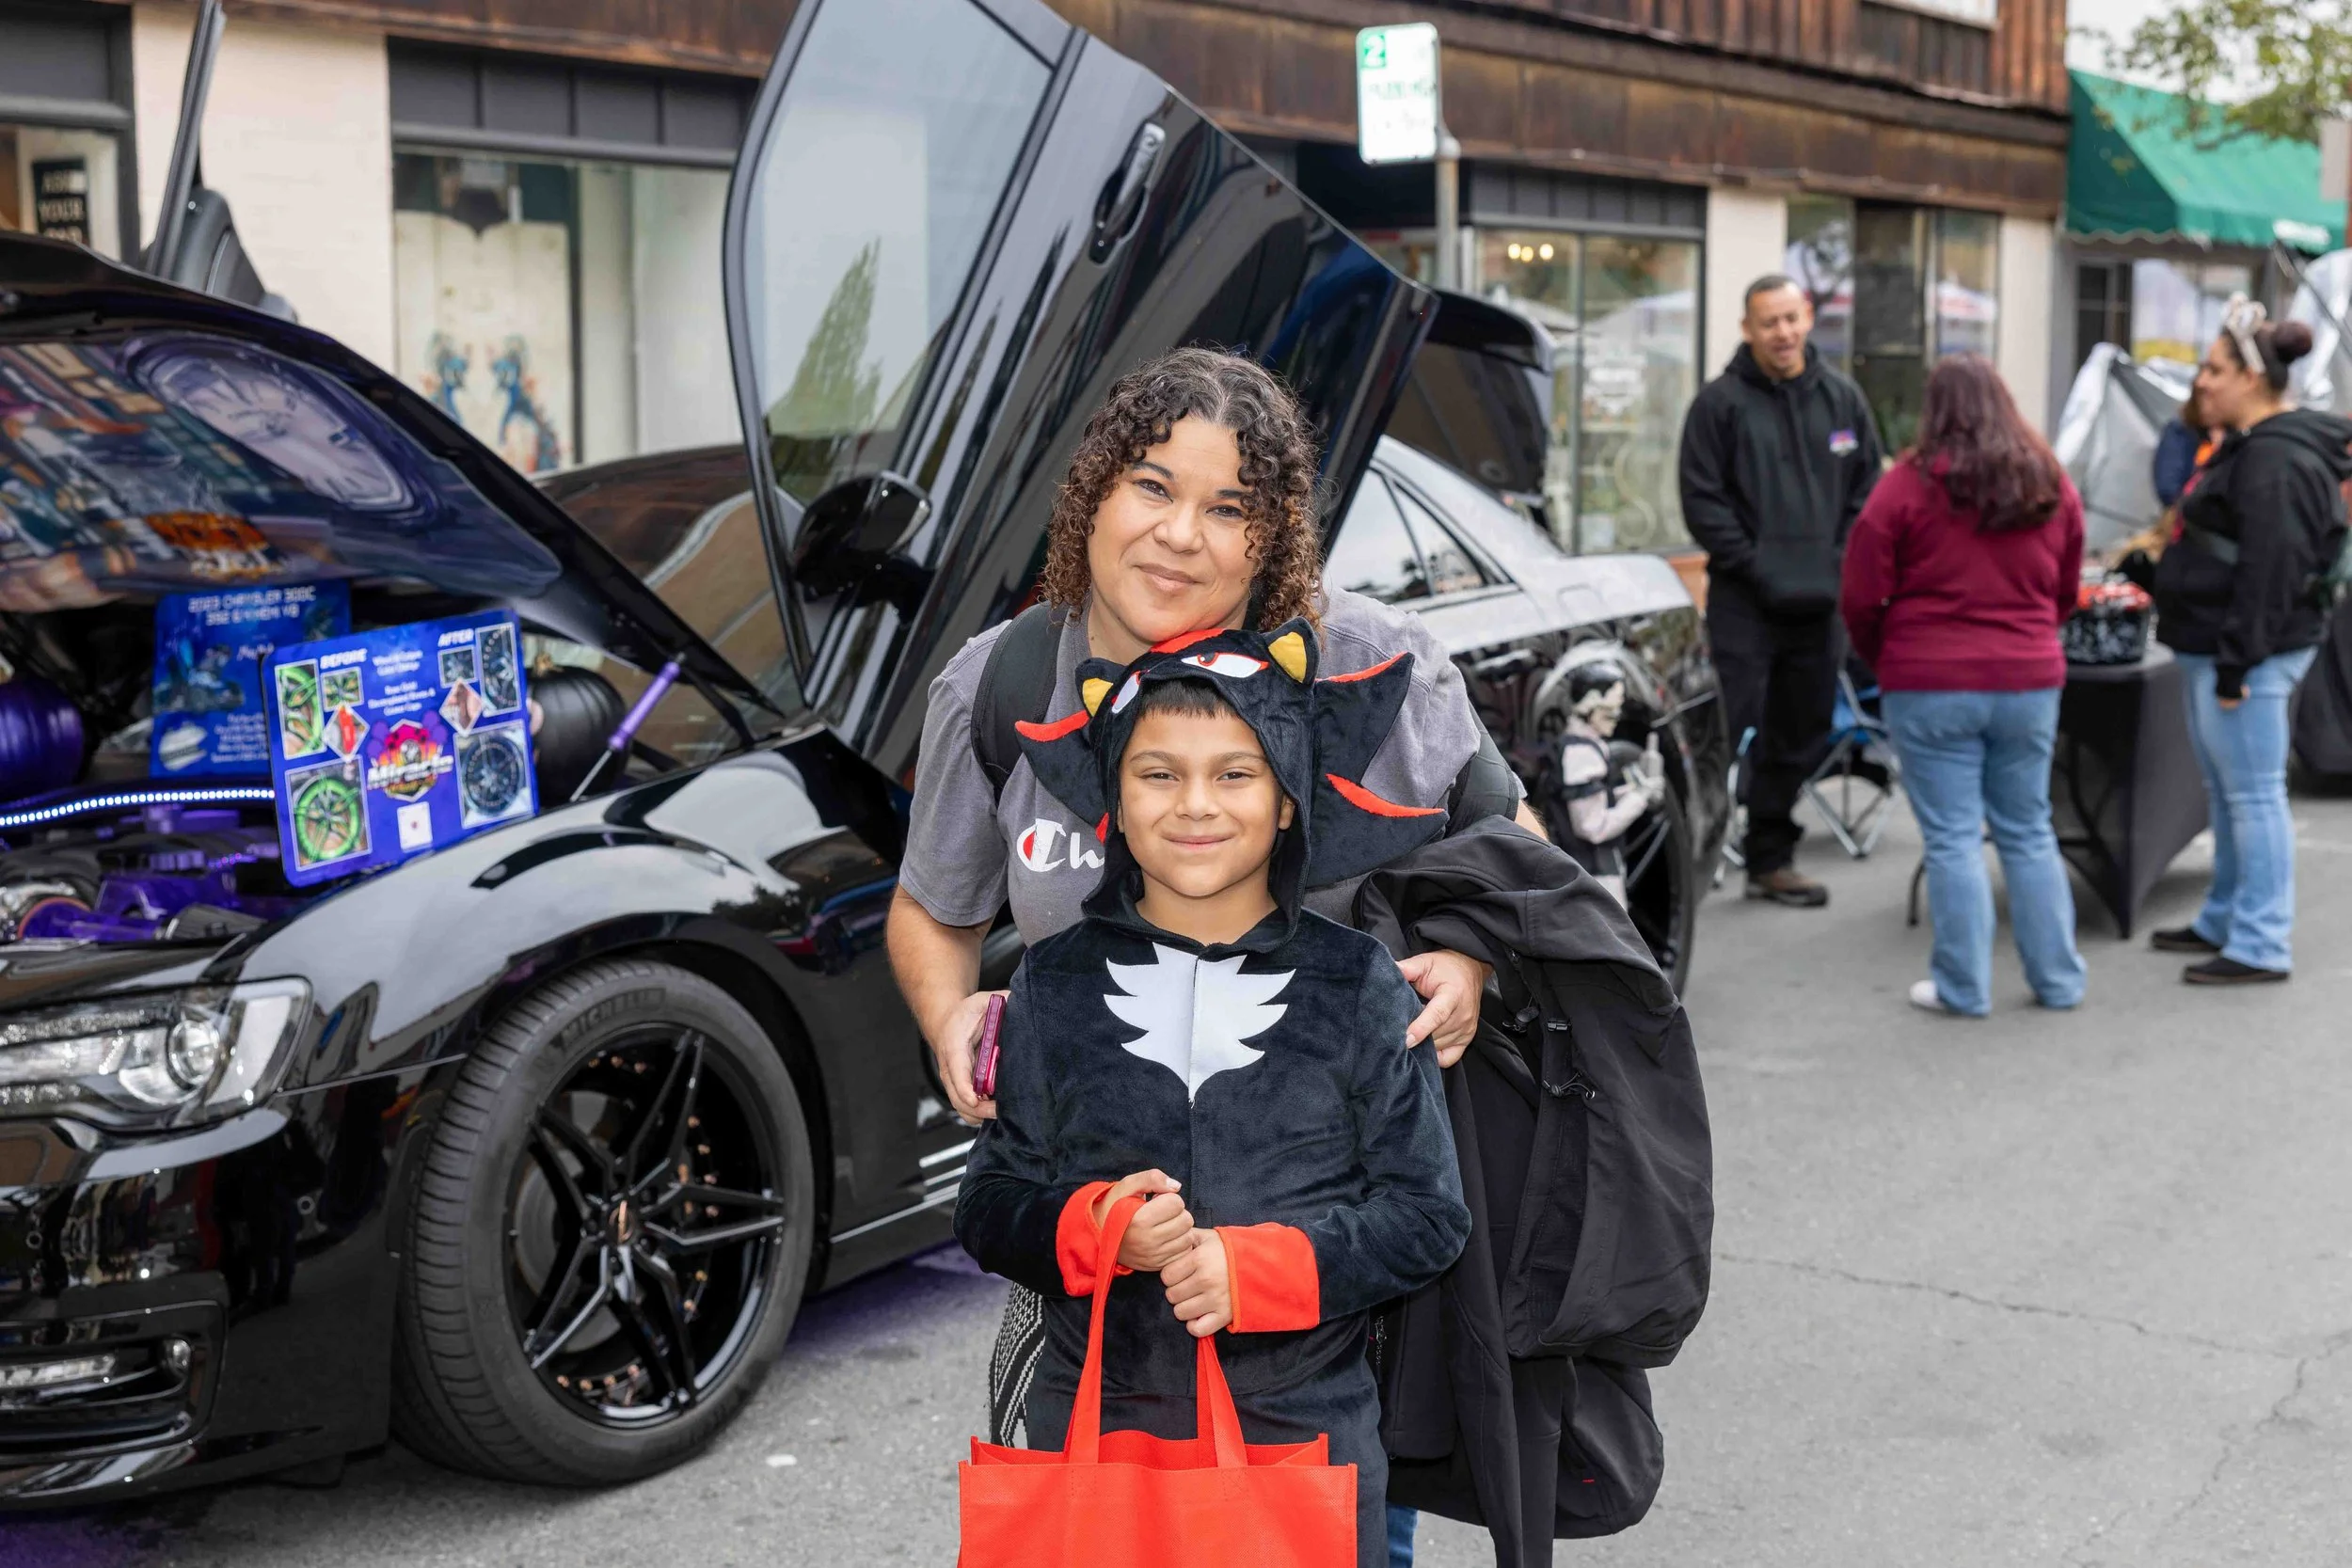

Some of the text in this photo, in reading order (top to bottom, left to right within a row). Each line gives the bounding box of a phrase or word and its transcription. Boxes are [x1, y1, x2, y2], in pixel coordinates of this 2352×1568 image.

[1364, 35, 1383, 65] 2
[222, 590, 281, 610] CHRYSLER
[284, 586, 316, 603] 300C
[437, 628, 474, 647] AFTER
[320, 648, 367, 670] BEFORE
